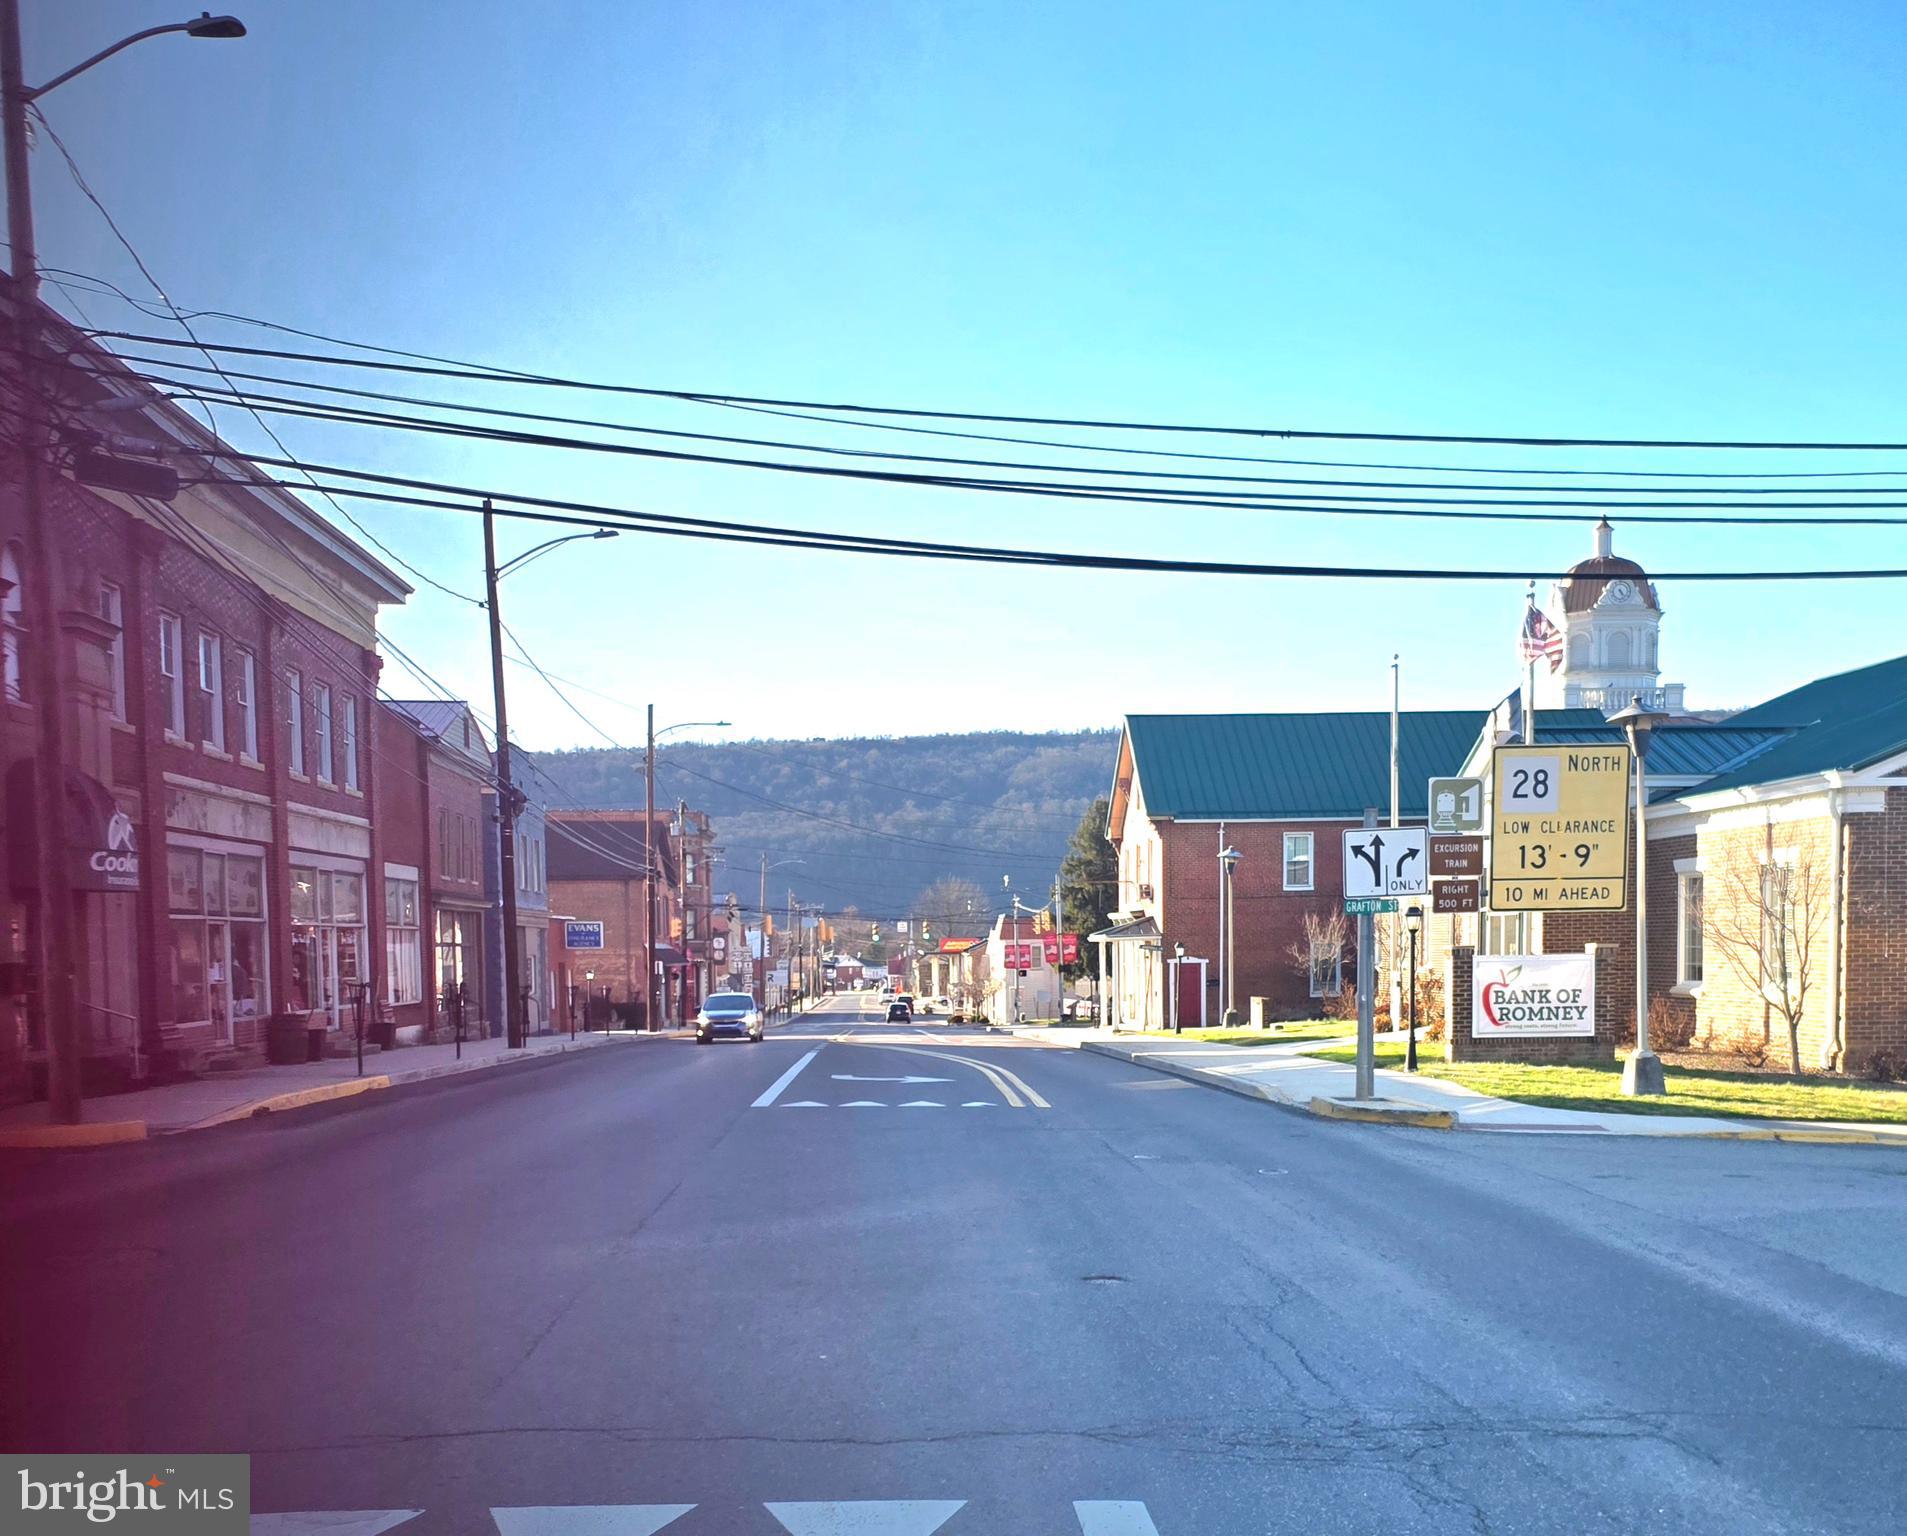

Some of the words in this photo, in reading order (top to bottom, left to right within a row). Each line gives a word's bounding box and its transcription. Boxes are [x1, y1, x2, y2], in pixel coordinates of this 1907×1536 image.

[1568, 754, 1621, 772] NORTH
[1512, 769, 1549, 798] 28
[1503, 821, 1530, 834] LOW
[1434, 844, 1479, 853] EXCURSION
[1445, 859, 1468, 868] TRAIN
[1390, 880, 1423, 891] ONLY
[1442, 885, 1469, 894] RIGHT
[1505, 887, 1523, 902] 10
[1533, 888, 1548, 900] MI
[1558, 887, 1610, 900] AHEAD
[1346, 901, 1381, 912] GRAFTON
[1388, 901, 1398, 911] ST
[1439, 900, 1457, 908] 500
[568, 924, 600, 932] EVANS
[1493, 990, 1552, 1005] BANK
[1556, 989, 1582, 1004] OF
[1498, 1006, 1588, 1022] ROMNEY
